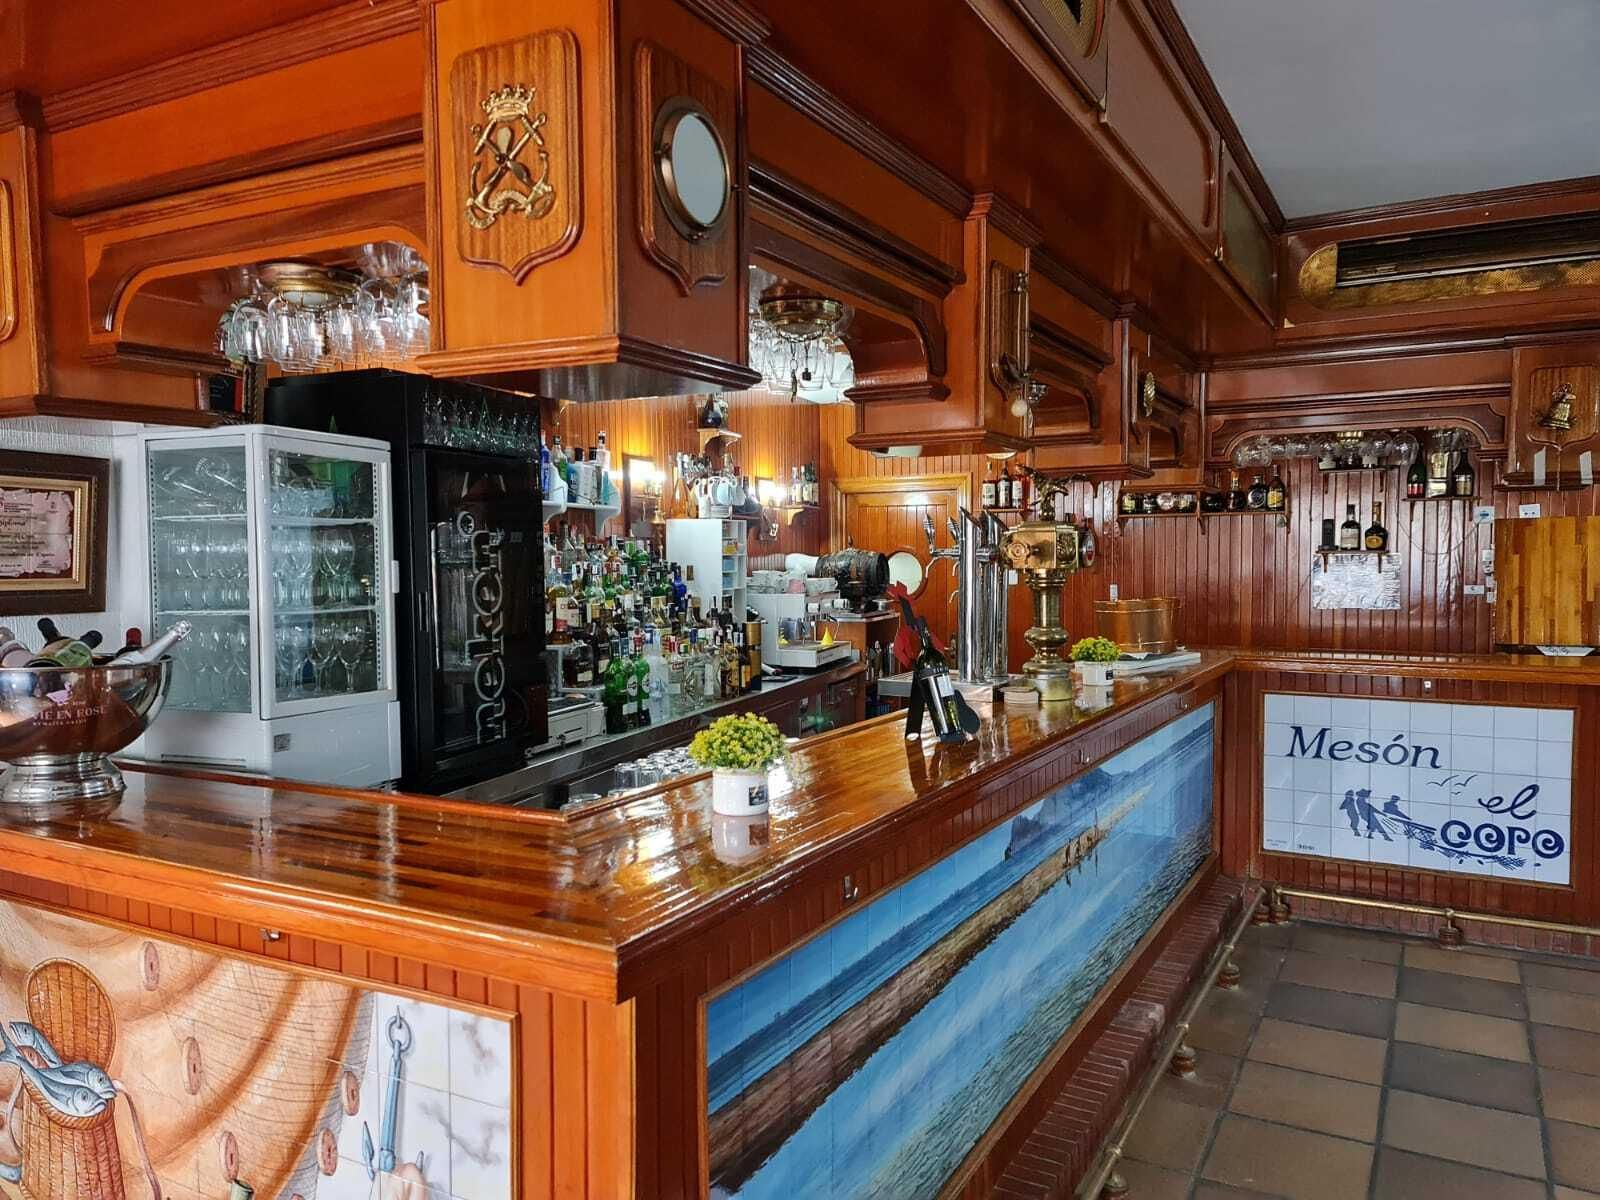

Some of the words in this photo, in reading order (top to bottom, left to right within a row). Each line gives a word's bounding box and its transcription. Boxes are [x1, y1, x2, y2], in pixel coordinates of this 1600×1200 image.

[56, 708, 72, 720] EN
[1286, 726, 1442, 769] Mesón
[1478, 784, 1540, 820] el
